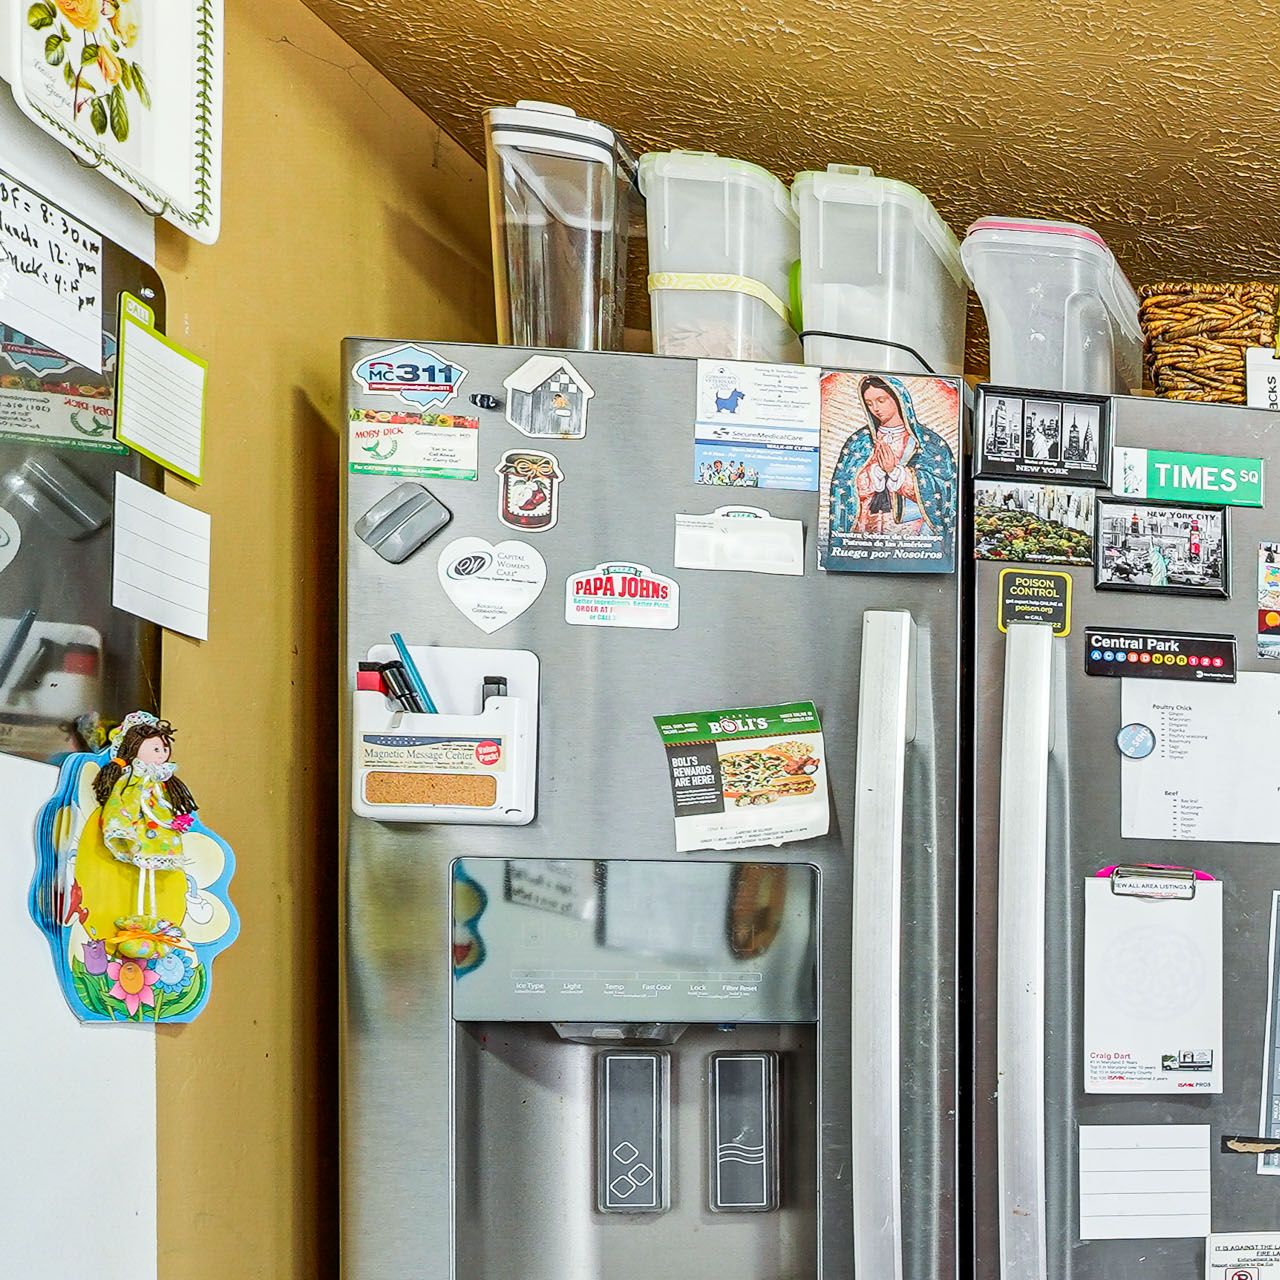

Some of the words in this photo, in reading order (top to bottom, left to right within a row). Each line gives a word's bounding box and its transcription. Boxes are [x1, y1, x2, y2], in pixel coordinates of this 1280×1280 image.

[383, 427, 405, 436] DICK
[1041, 466, 1069, 475] YORK
[1155, 463, 1237, 492] TIMES
[1240, 469, 1259, 483] SQ
[1147, 511, 1167, 519] NEW
[1169, 512, 1194, 520] YORK
[1196, 513, 1217, 521] CITY
[831, 547, 869, 559] Ruega
[869, 550, 891, 559] por
[893, 550, 943, 559] Nosotros
[575, 577, 615, 597] PAPA
[618, 576, 668, 600] JOHNS
[1015, 577, 1055, 588] POISON
[1010, 587, 1060, 598] CONTROL
[576, 605, 599, 613] ORDER
[1015, 605, 1053, 614] poison.org
[1091, 635, 1143, 650] Central
[1147, 638, 1180, 652] Park
[708, 717, 769, 734] BOLI'S
[364, 749, 405, 760] Magnetic
[406, 750, 443, 761] Message
[445, 751, 473, 760] Center
[478, 745, 497, 754] Value
[671, 755, 699, 767] BOLI'S
[673, 765, 712, 777] REWARDS
[675, 776, 690, 788] ARE
[690, 774, 716, 785] HERE!
[1090, 1052, 1111, 1060] Craig
